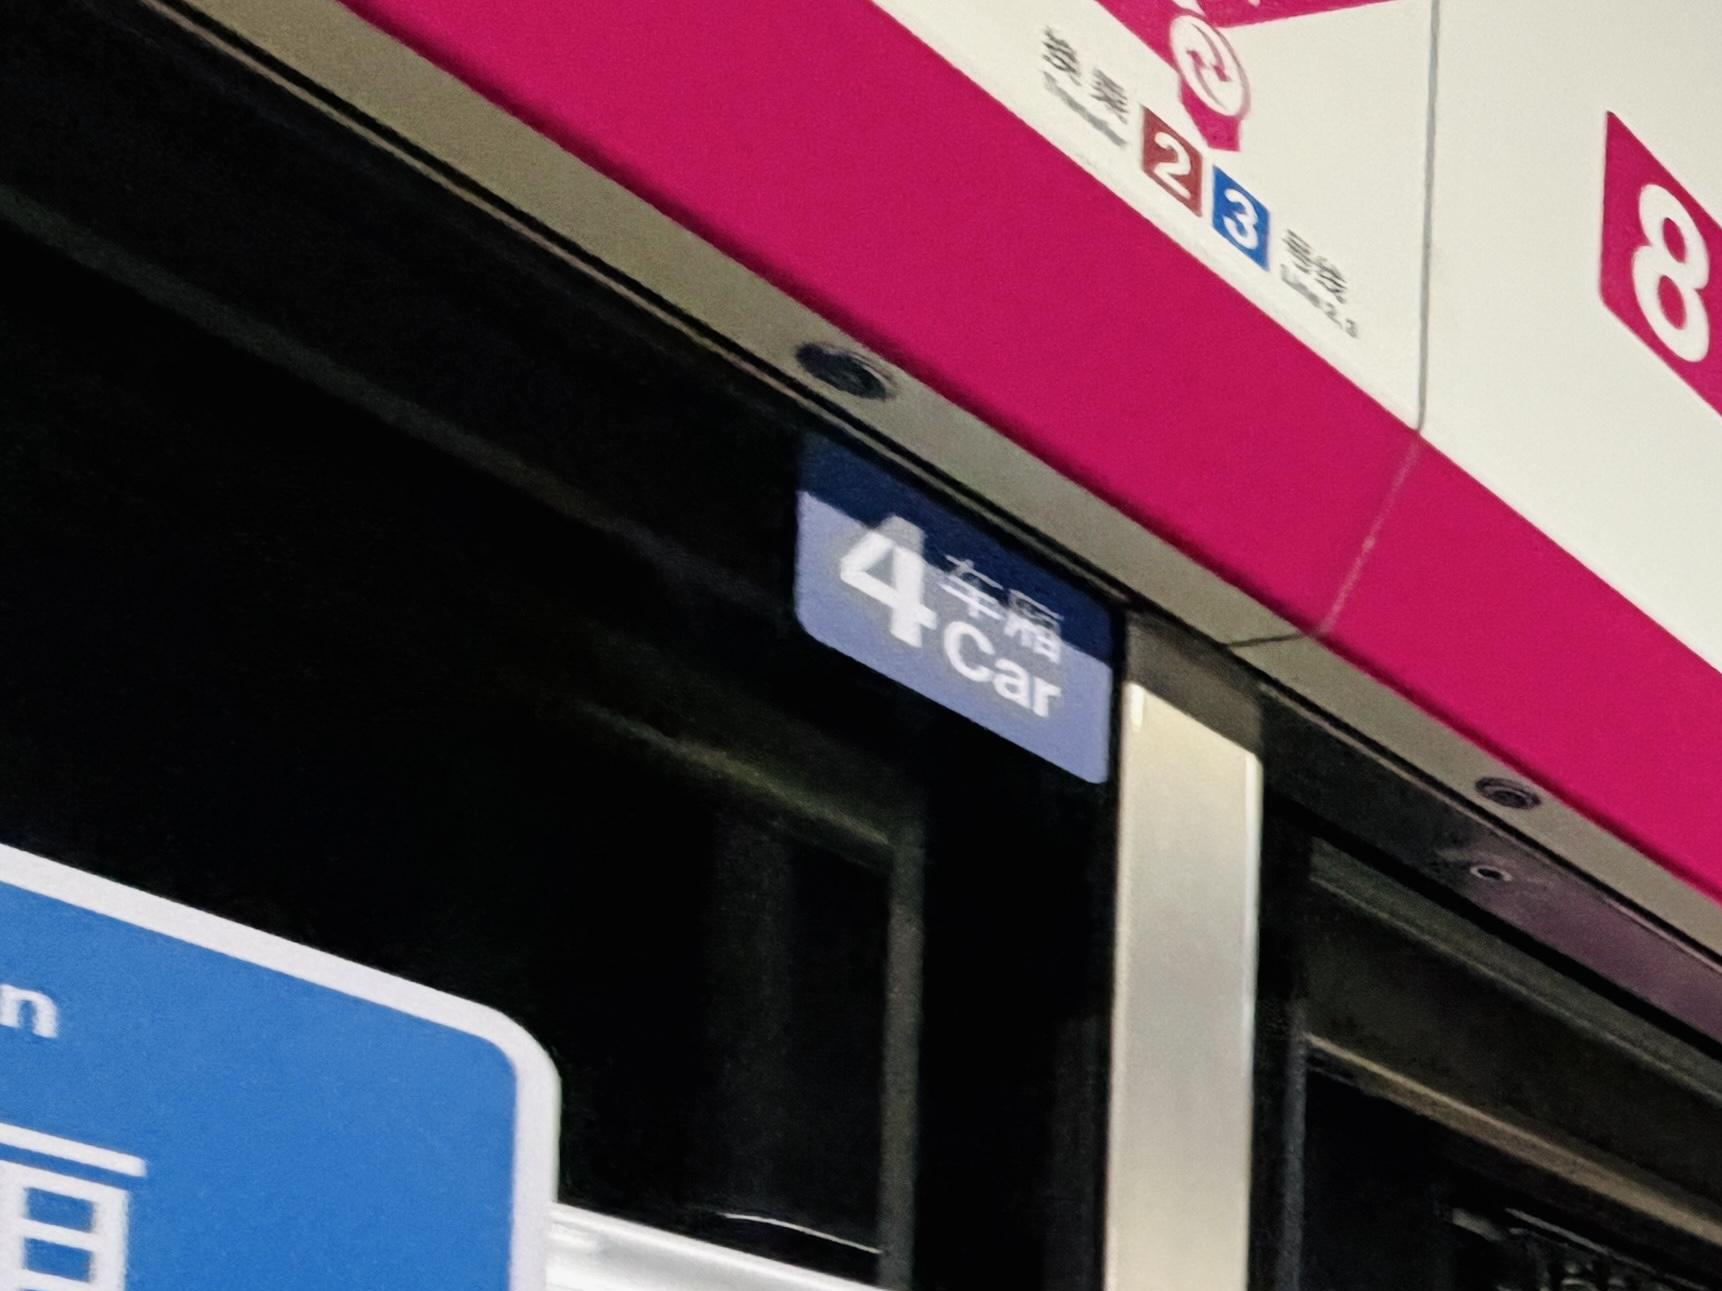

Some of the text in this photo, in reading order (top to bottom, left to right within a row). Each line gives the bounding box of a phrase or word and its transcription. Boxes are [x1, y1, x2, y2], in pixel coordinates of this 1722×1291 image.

[1154, 131, 1193, 200] 2
[1222, 188, 1259, 250] 3
[1631, 183, 1711, 363] 8
[840, 514, 1064, 663] 4 车厢
[944, 621, 1062, 718] Car
